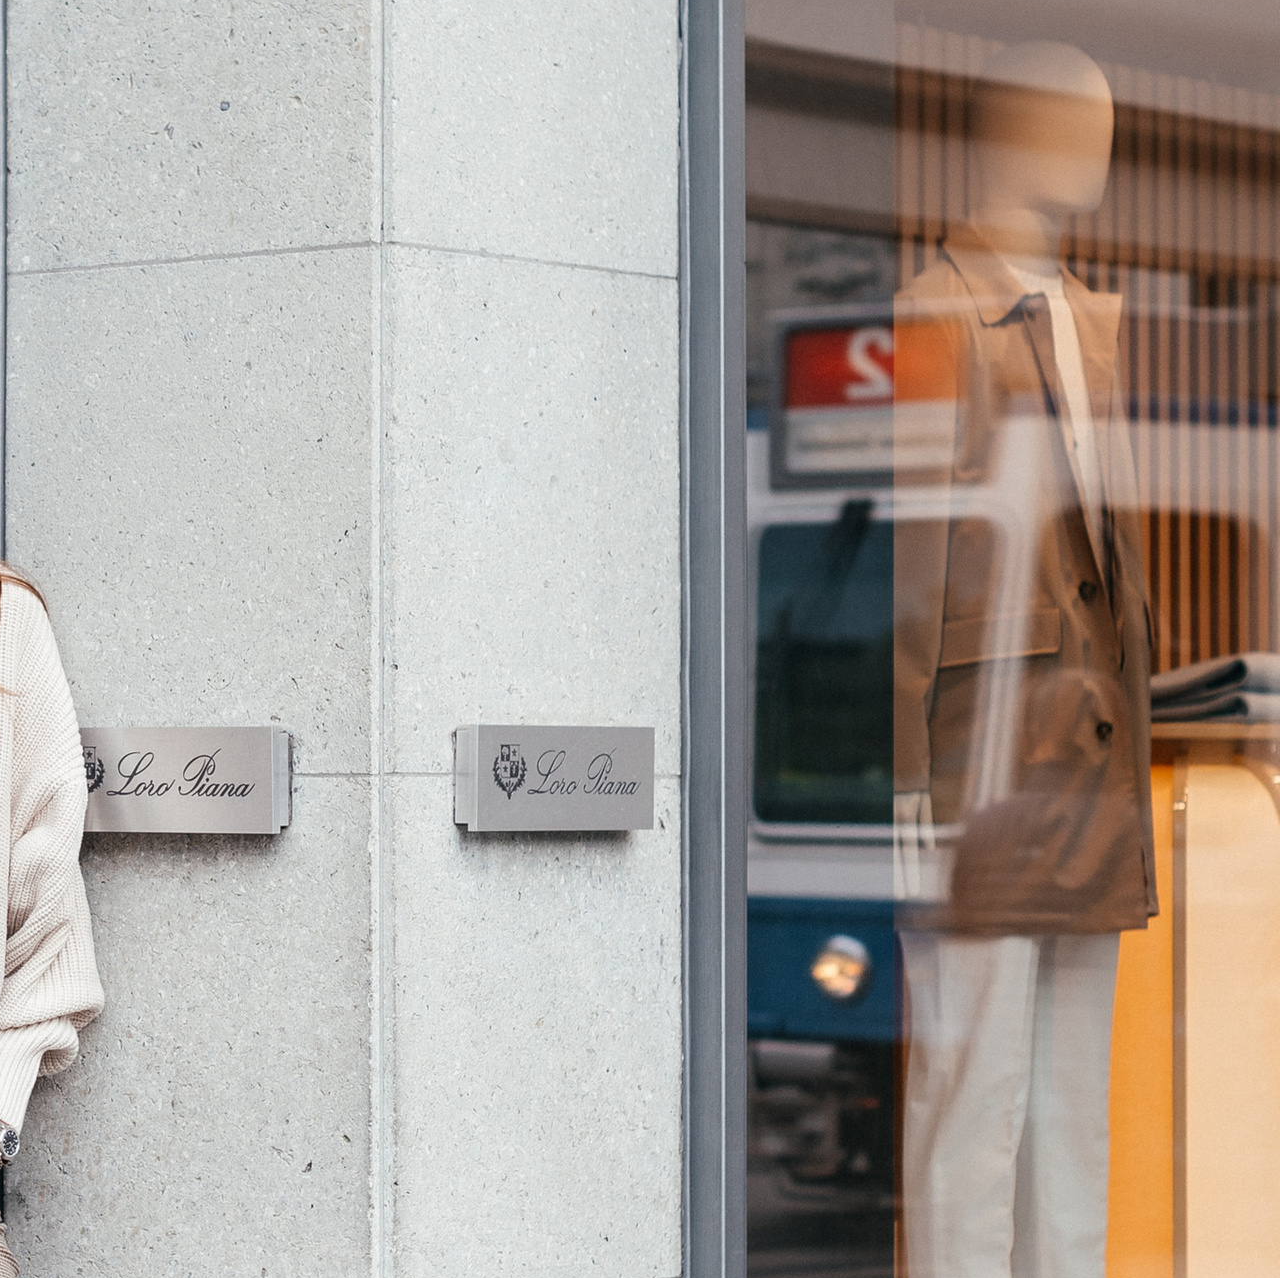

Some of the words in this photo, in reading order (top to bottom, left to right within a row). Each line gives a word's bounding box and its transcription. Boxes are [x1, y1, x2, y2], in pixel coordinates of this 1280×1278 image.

[106, 751, 176, 797] Loro
[178, 747, 256, 798] Piana
[527, 749, 582, 795] Loro
[583, 747, 641, 796] Piana
